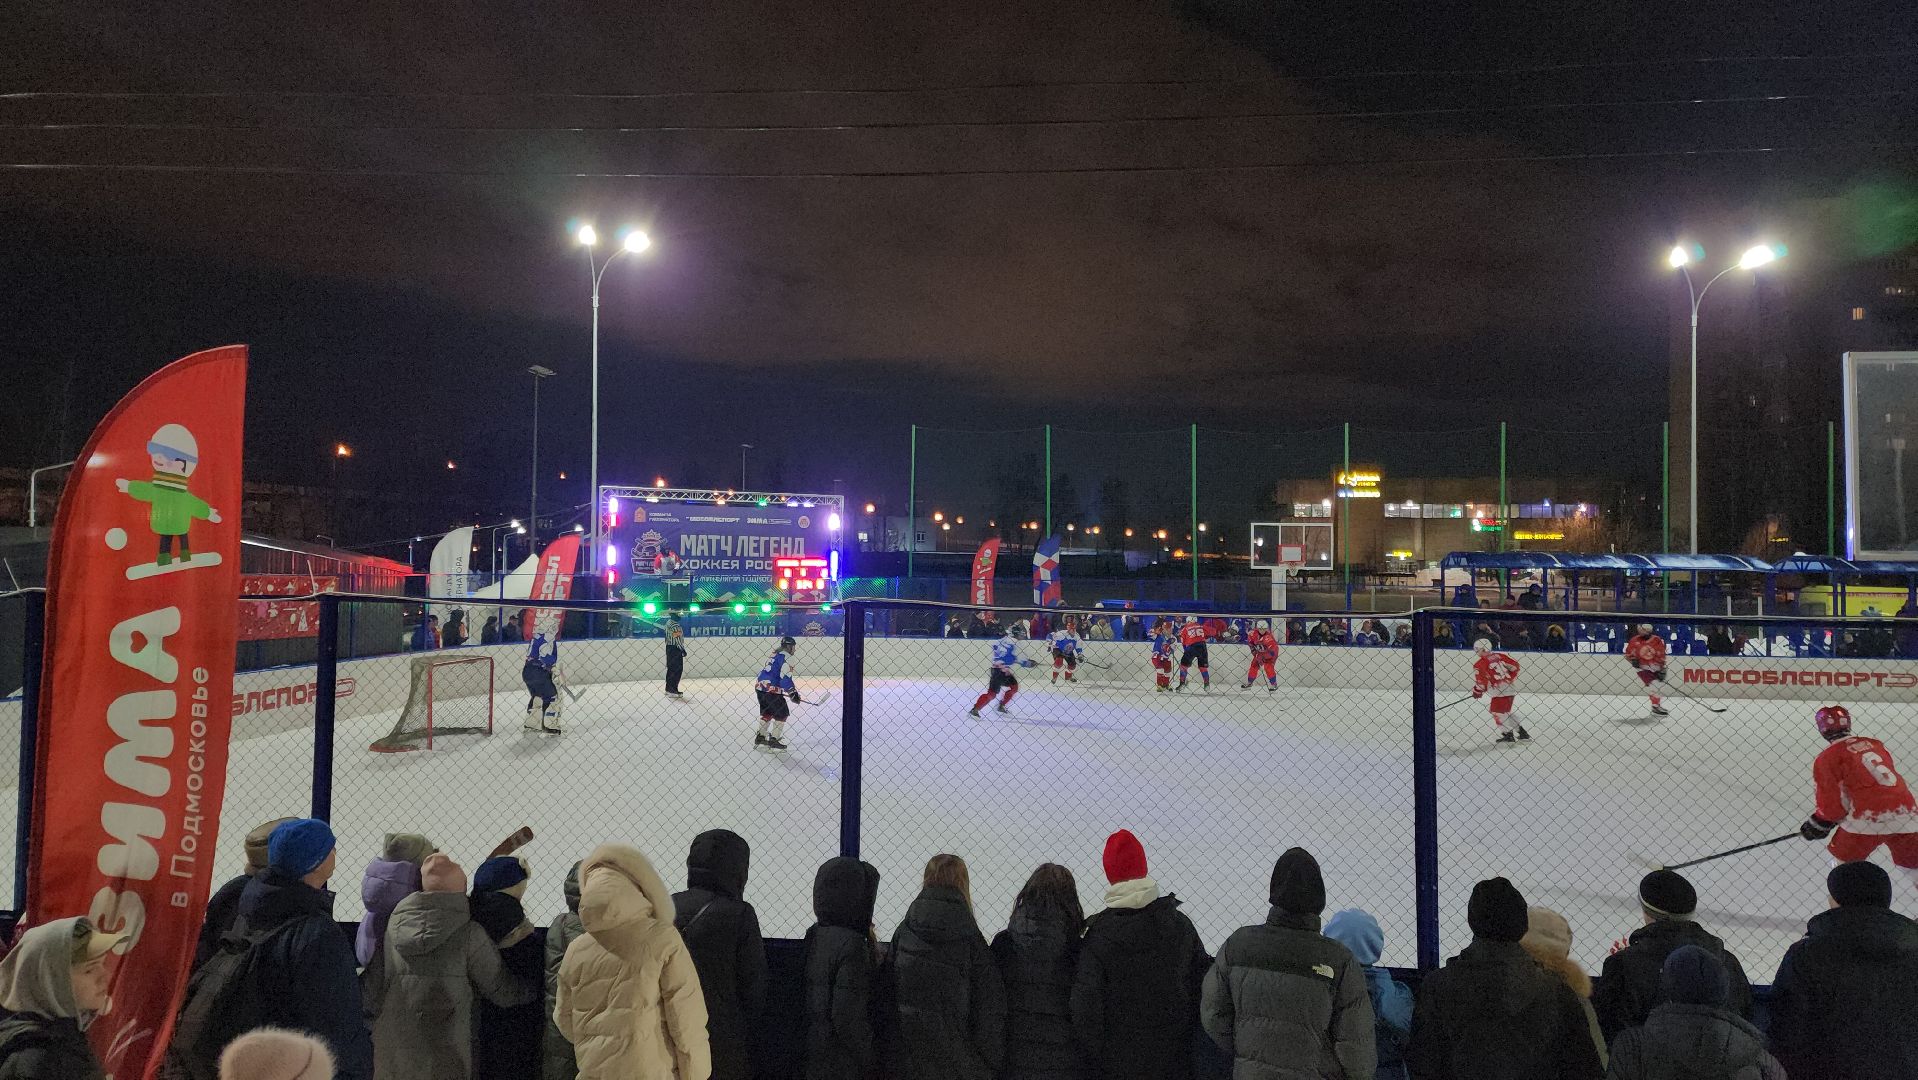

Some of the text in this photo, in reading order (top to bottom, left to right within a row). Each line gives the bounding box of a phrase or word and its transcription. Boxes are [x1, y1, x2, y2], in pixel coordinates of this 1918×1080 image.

[680, 535, 806, 558] МАТЧ ЛЕГЕНД
[679, 558, 739, 570] ХОККЕЯ
[745, 559, 773, 571] РОС
[1683, 668, 1889, 688] МОСОБЛСПОРТ
[1861, 751, 1898, 787] 6
[169, 666, 209, 908] в Подмосковье
